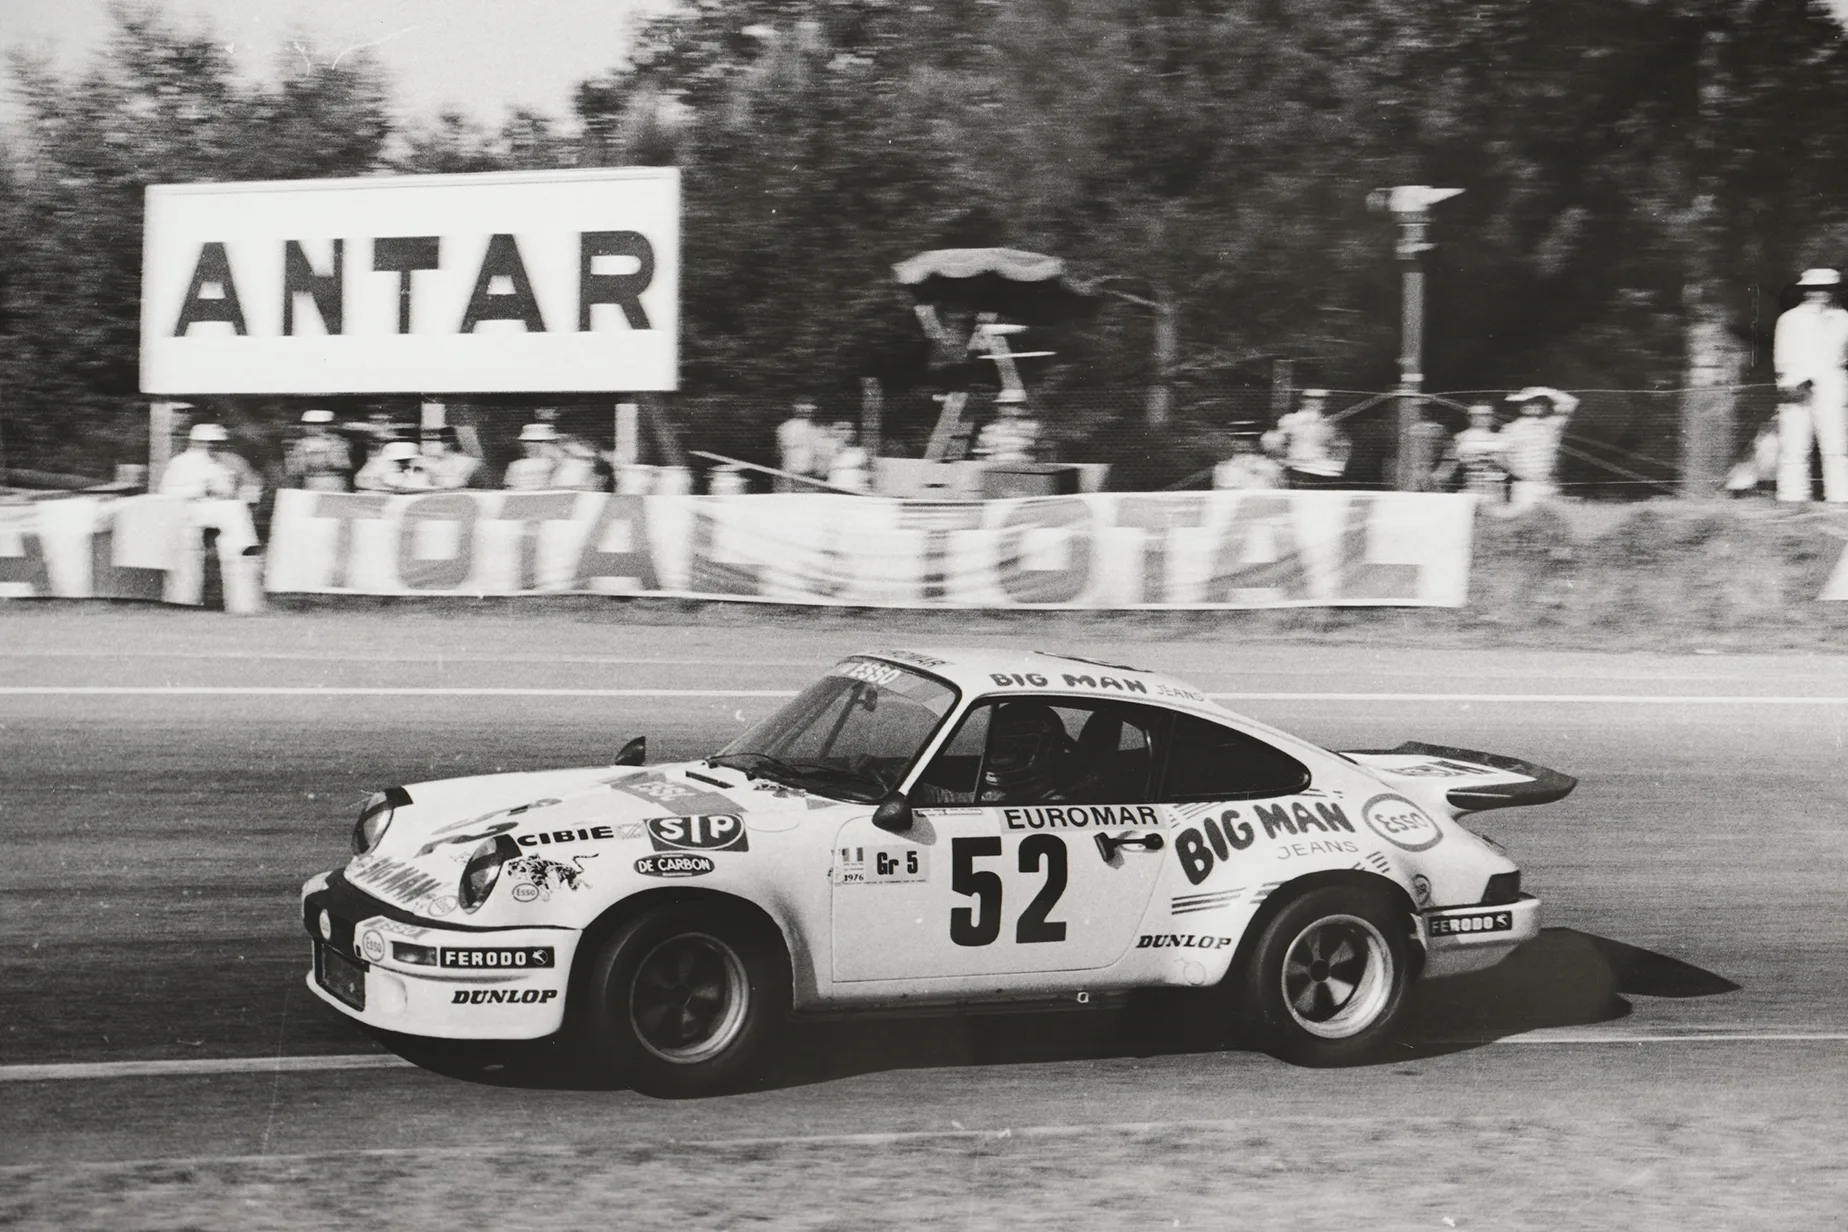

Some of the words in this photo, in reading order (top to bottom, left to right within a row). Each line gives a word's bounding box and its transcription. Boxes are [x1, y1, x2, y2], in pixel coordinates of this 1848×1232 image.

[174, 229, 655, 337] ANTAR
[314, 491, 763, 597] TOTAL
[898, 496, 1424, 603] TOTAL
[989, 672, 1048, 688] BIG
[1061, 673, 1148, 695] MAN
[659, 814, 734, 843] STP
[1004, 804, 1160, 830] EUROMAR
[516, 825, 615, 848] CIBIE
[1175, 809, 1256, 886] BIG
[1252, 801, 1356, 841] MAN
[1276, 839, 1359, 860] JEANS
[637, 858, 655, 873] DE
[657, 857, 711, 873] CARBON
[876, 851, 899, 875] Gr
[906, 850, 918, 874] 5
[843, 873, 865, 882] 1976
[515, 887, 537, 898] Esso
[949, 833, 1068, 948] 52
[1431, 916, 1494, 933] FERODO
[1136, 933, 1232, 950] DUNLOP
[445, 950, 527, 967] FERODO
[451, 988, 558, 1005] DUNLOP
